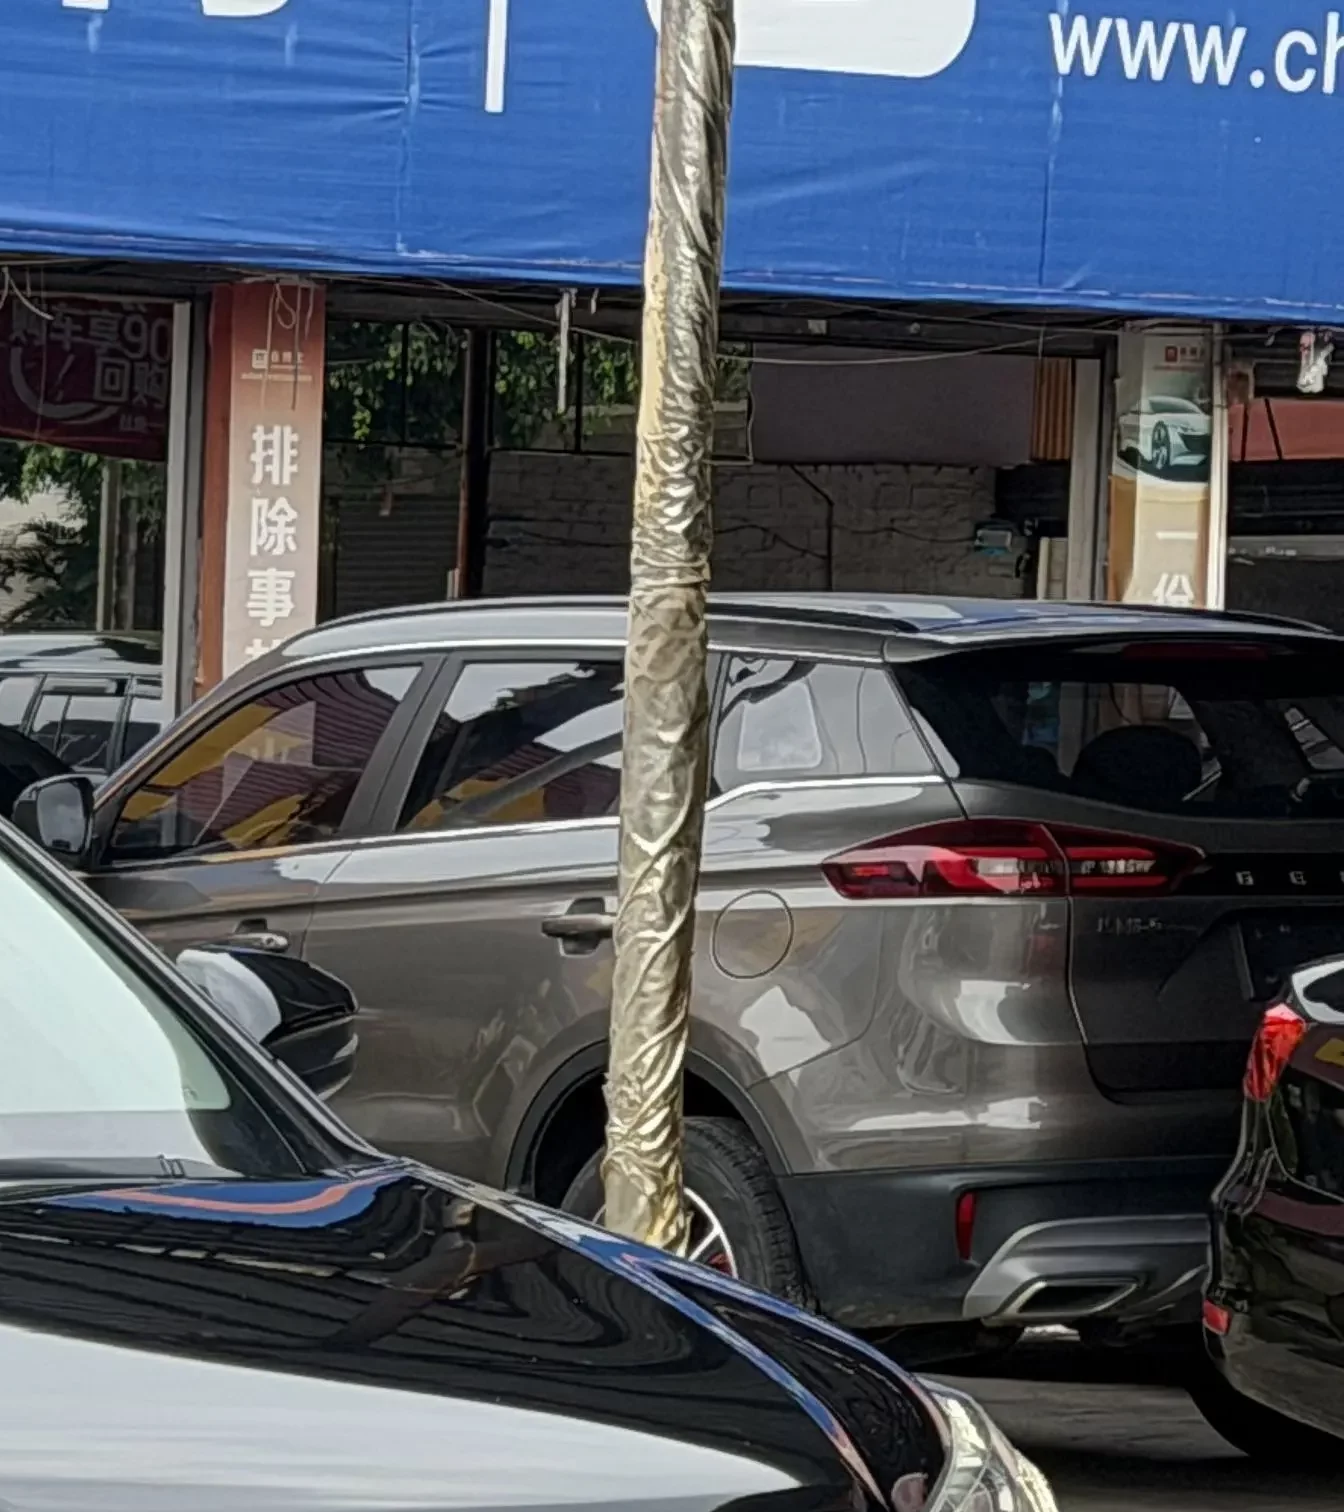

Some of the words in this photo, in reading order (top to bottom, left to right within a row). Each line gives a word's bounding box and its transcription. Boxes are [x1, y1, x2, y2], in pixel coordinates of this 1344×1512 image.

[1048, 11, 1344, 94] www.ch
[245, 424, 299, 660] 排除事
